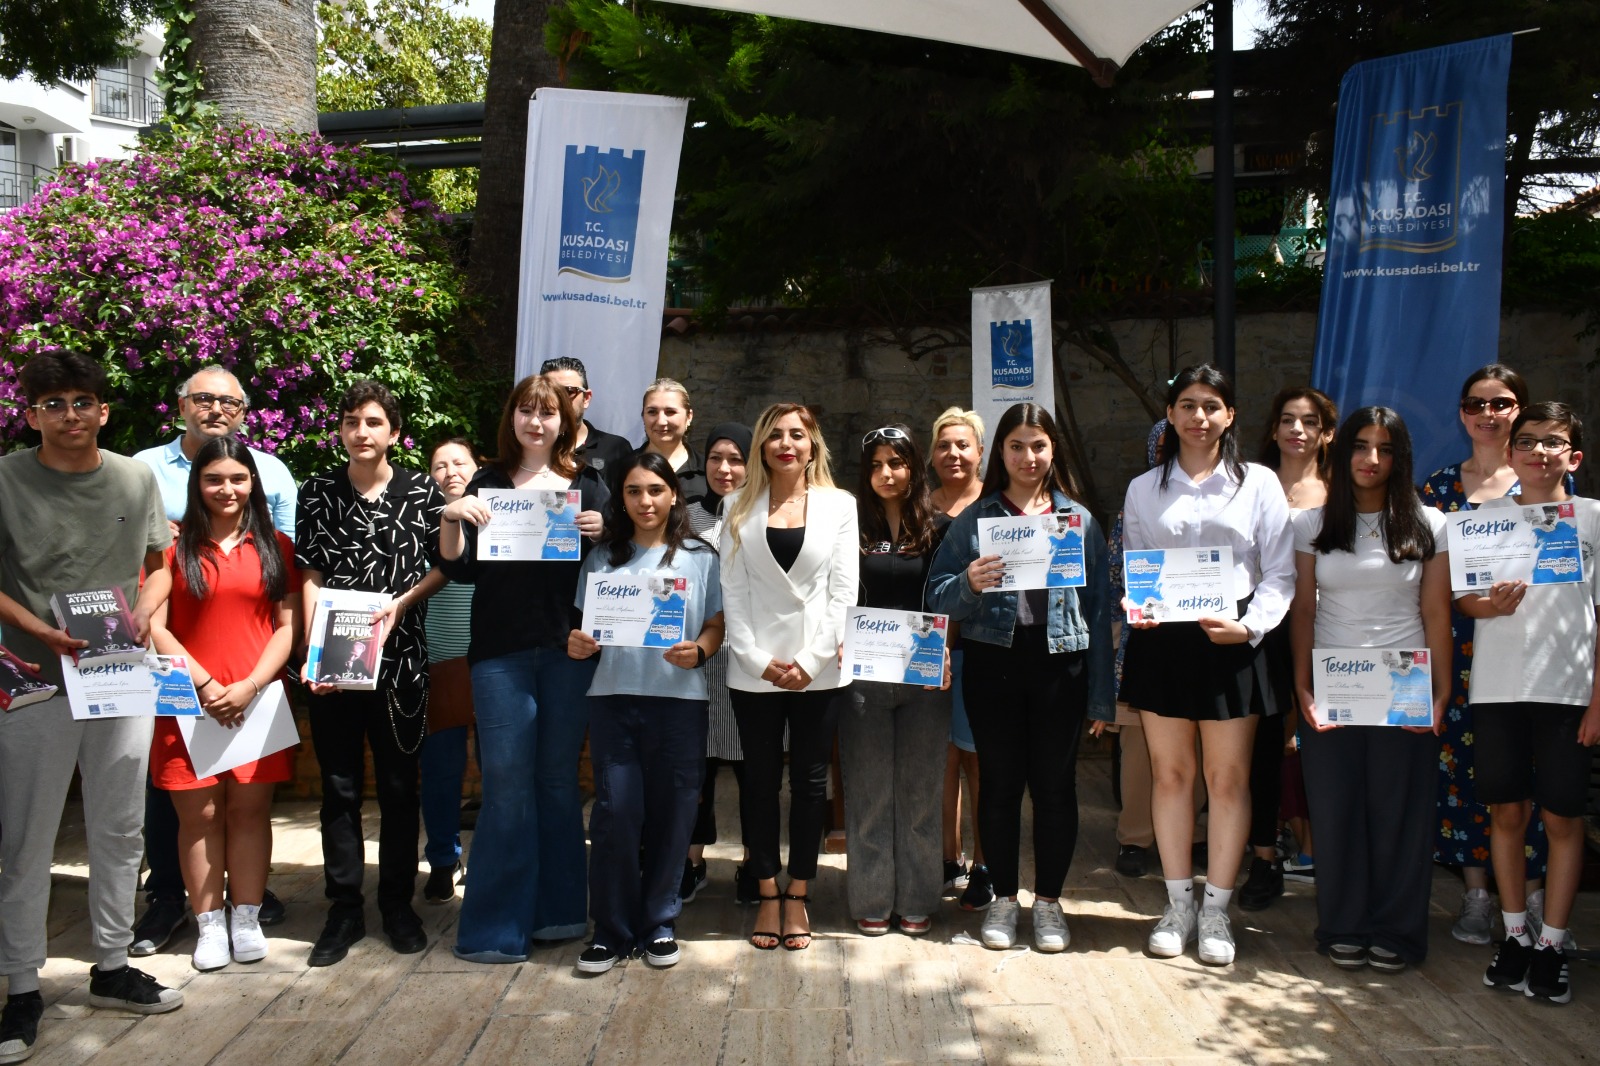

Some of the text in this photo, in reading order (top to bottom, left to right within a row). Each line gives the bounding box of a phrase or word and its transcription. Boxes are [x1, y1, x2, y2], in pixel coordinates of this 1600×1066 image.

[1403, 192, 1425, 202] T.C.
[585, 222, 604, 232] T.C.
[1369, 220, 1450, 234] BELEDİYESİ
[562, 250, 627, 264] BELEDİYESİ
[1343, 262, 1480, 278] www.kusadasi.bel.tr
[542, 290, 647, 309] www.kusadasi.bel.tr
[68, 593, 115, 604] ATATÜRK
[70, 602, 120, 615] NUTUK
[333, 626, 372, 636] NUTUK
